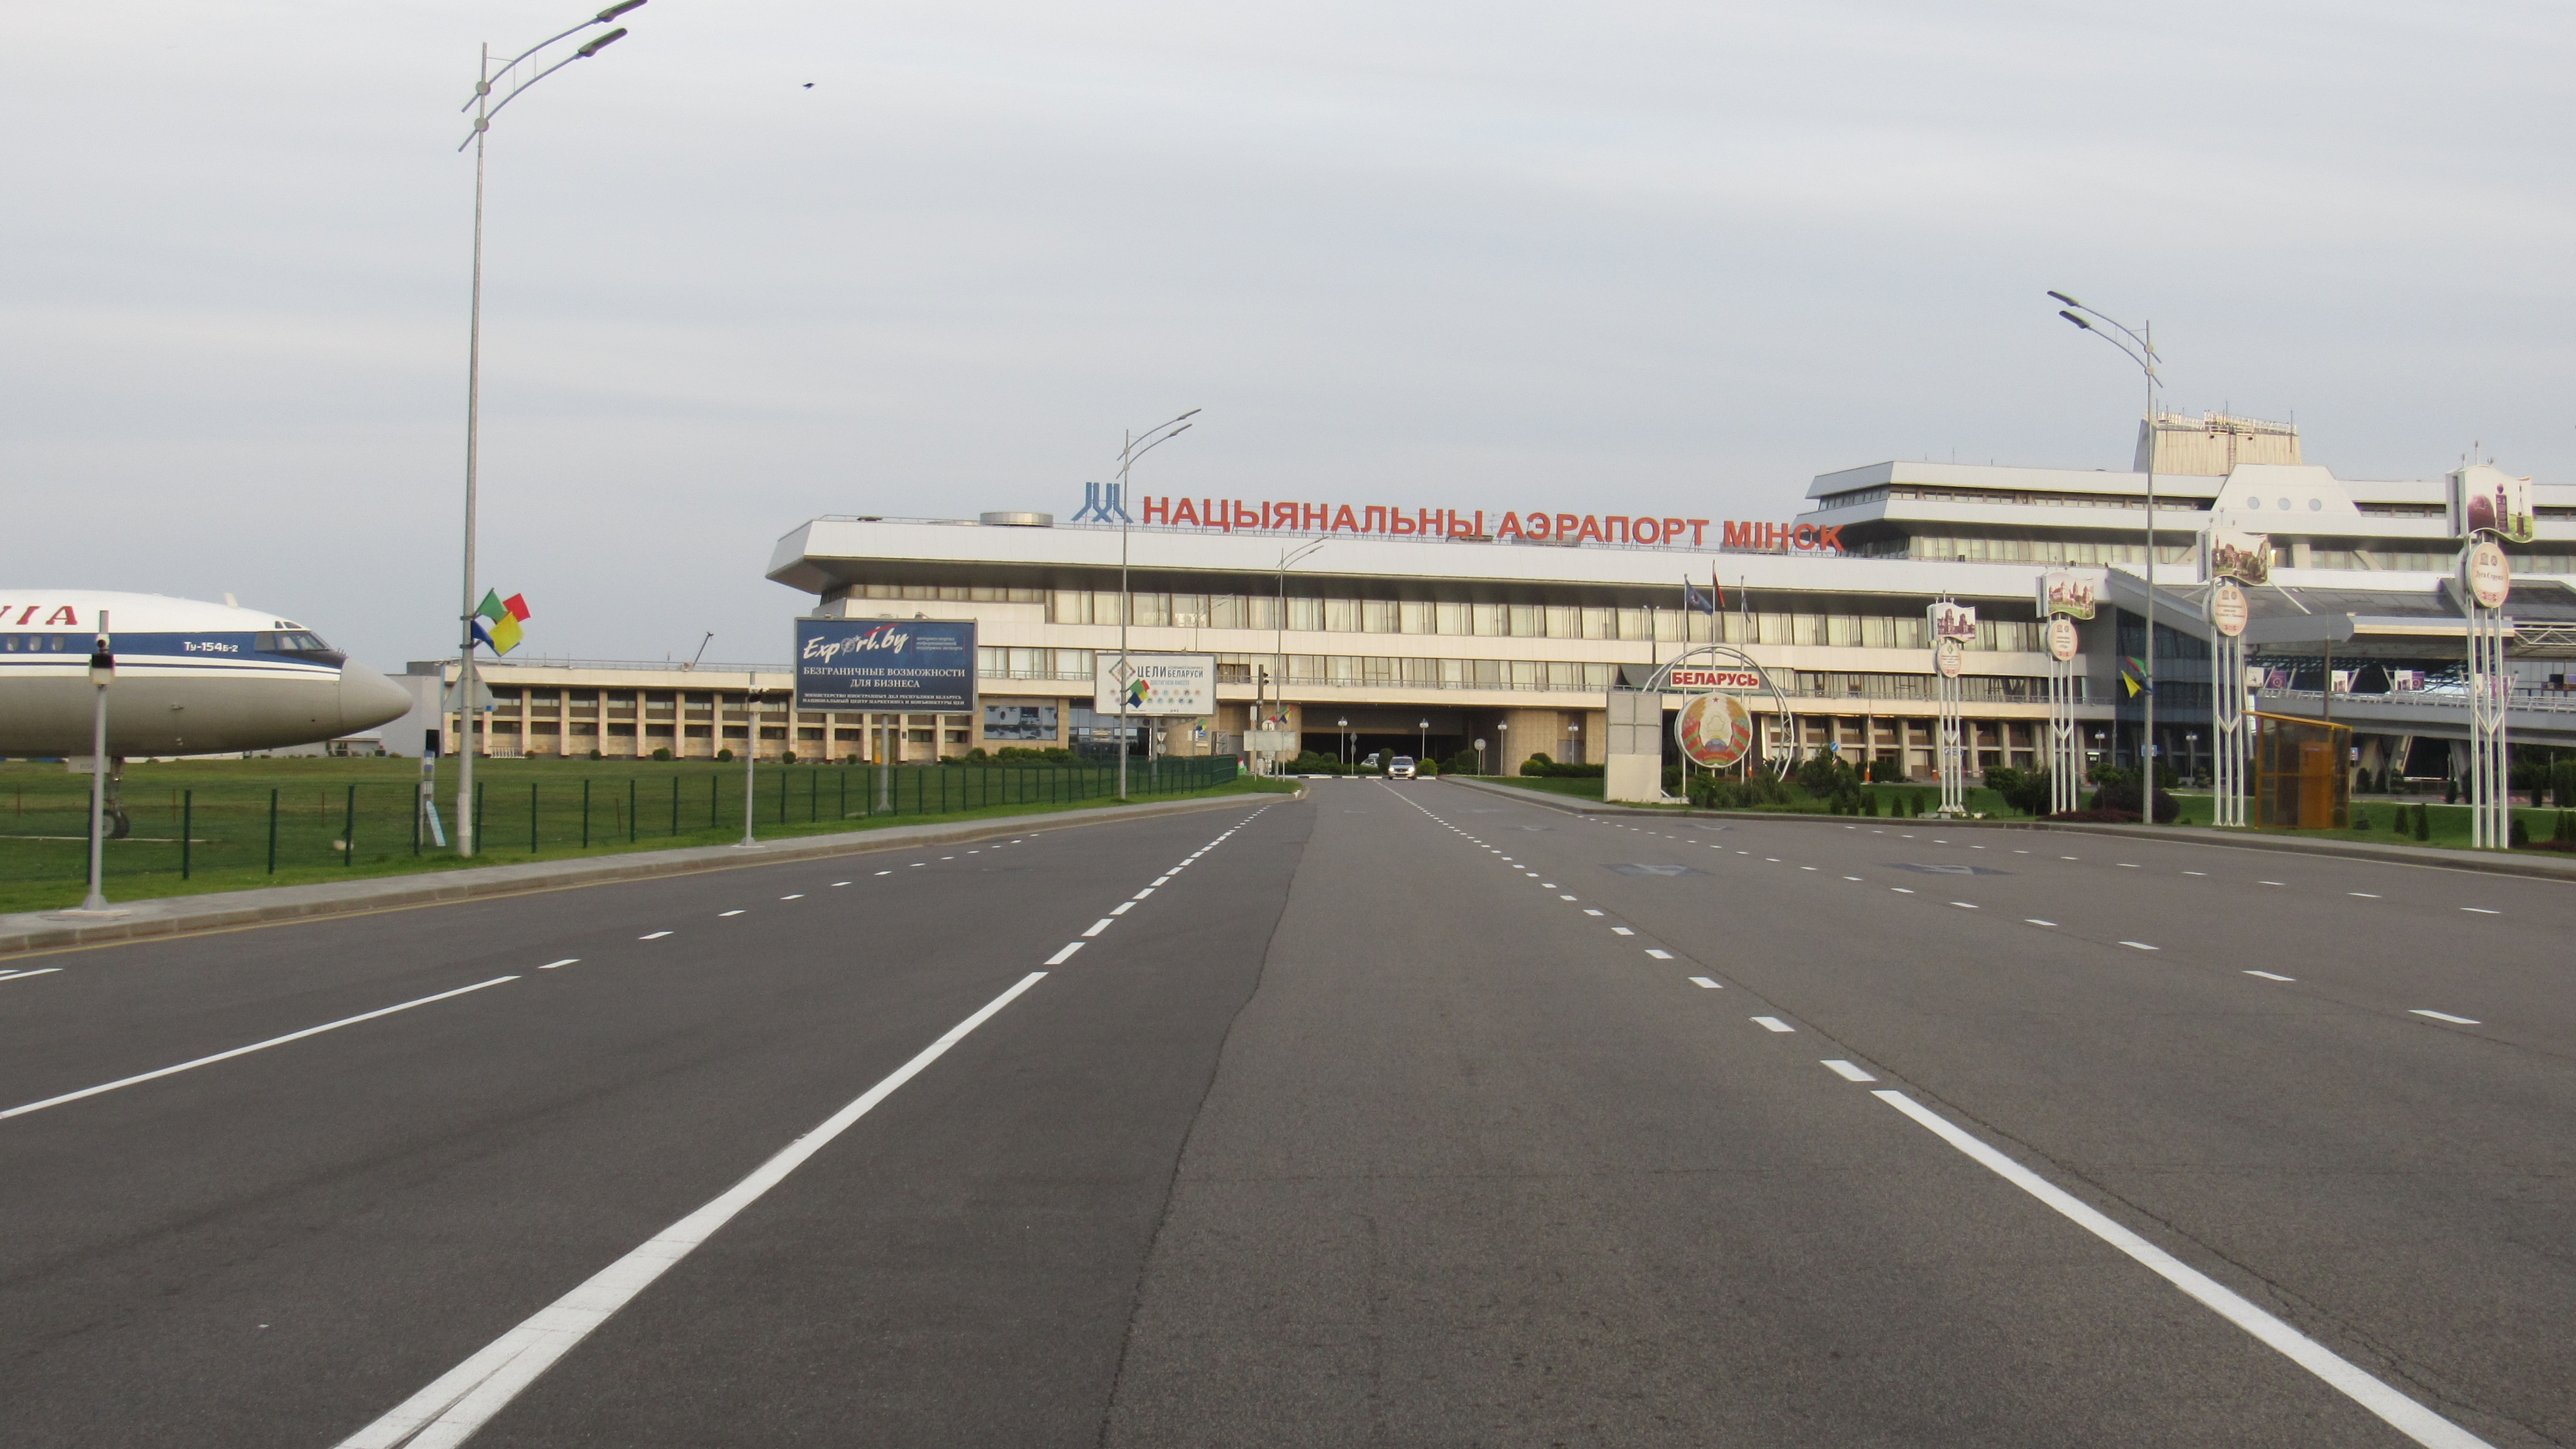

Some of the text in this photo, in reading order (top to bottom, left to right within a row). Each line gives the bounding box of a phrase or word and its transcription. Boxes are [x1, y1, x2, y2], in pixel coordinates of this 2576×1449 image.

[1143, 496, 1844, 551] НАЦЫЯНАЛЬНЫ АЭРАПОРТ МІНСК
[0, 605, 78, 625] IA
[803, 626, 910, 664] Export.by
[803, 666, 965, 677] БЕЗГРАНИЧНЫЕ ВОЗМОЖНОСТИ
[1138, 666, 1166, 678] ЦЕЛИ
[850, 679, 920, 688] ДЛЯ БИЗНЕСА
[1671, 672, 1758, 686] БЕЛАРУСЬ
